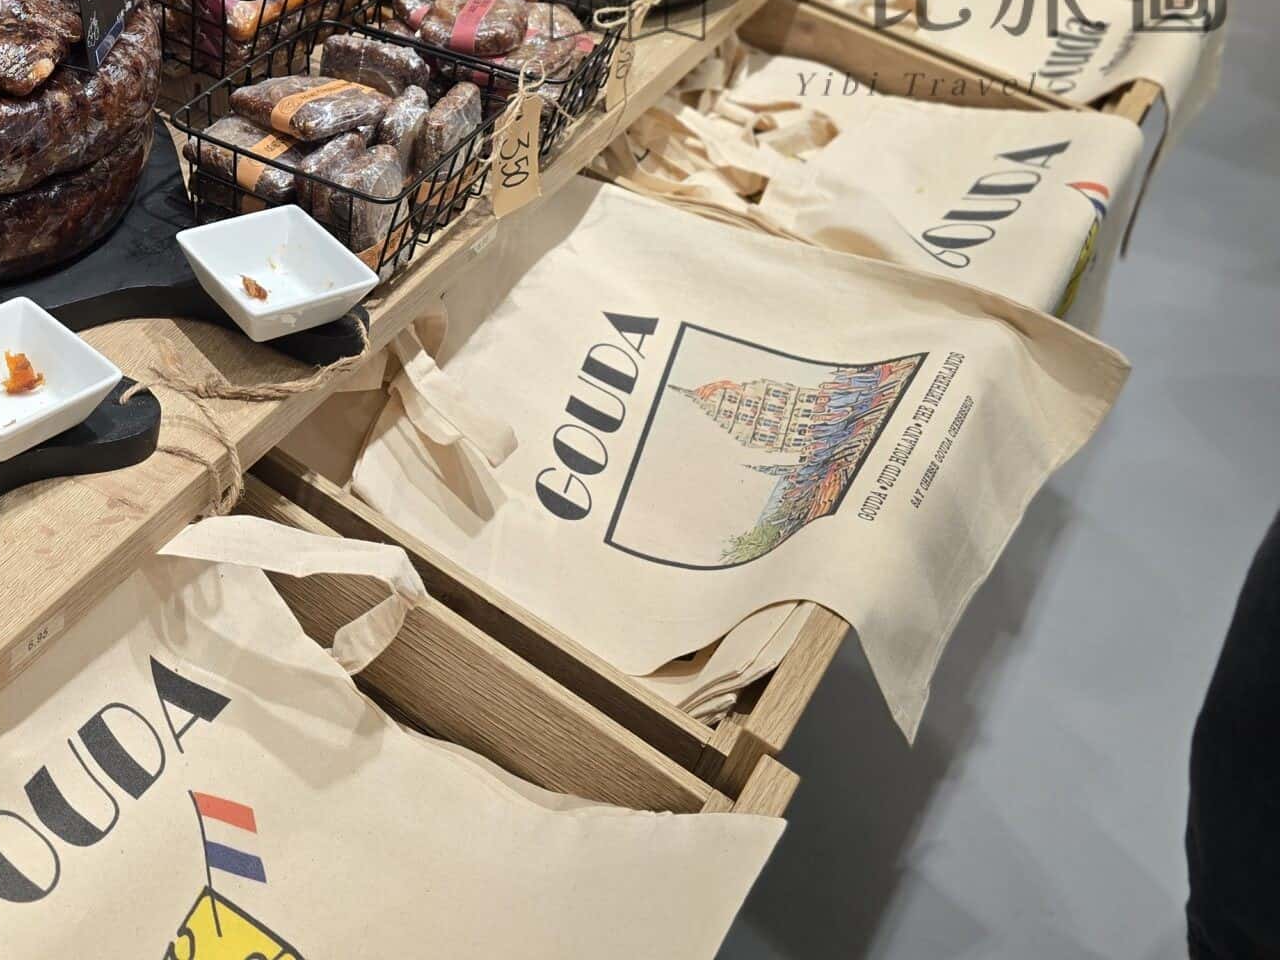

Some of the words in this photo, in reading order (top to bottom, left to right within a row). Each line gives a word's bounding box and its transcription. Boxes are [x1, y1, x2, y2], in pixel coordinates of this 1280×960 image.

[535, 311, 660, 521] GOUDA
[857, 490, 888, 522] GOUDA
[888, 424, 923, 467] HOLLAND
[912, 405, 929, 424] THE
[923, 351, 966, 407] NETHERLANDS
[910, 488, 925, 509] SAY
[919, 460, 941, 492] CHEESE
[934, 437, 953, 464] GOUDA
